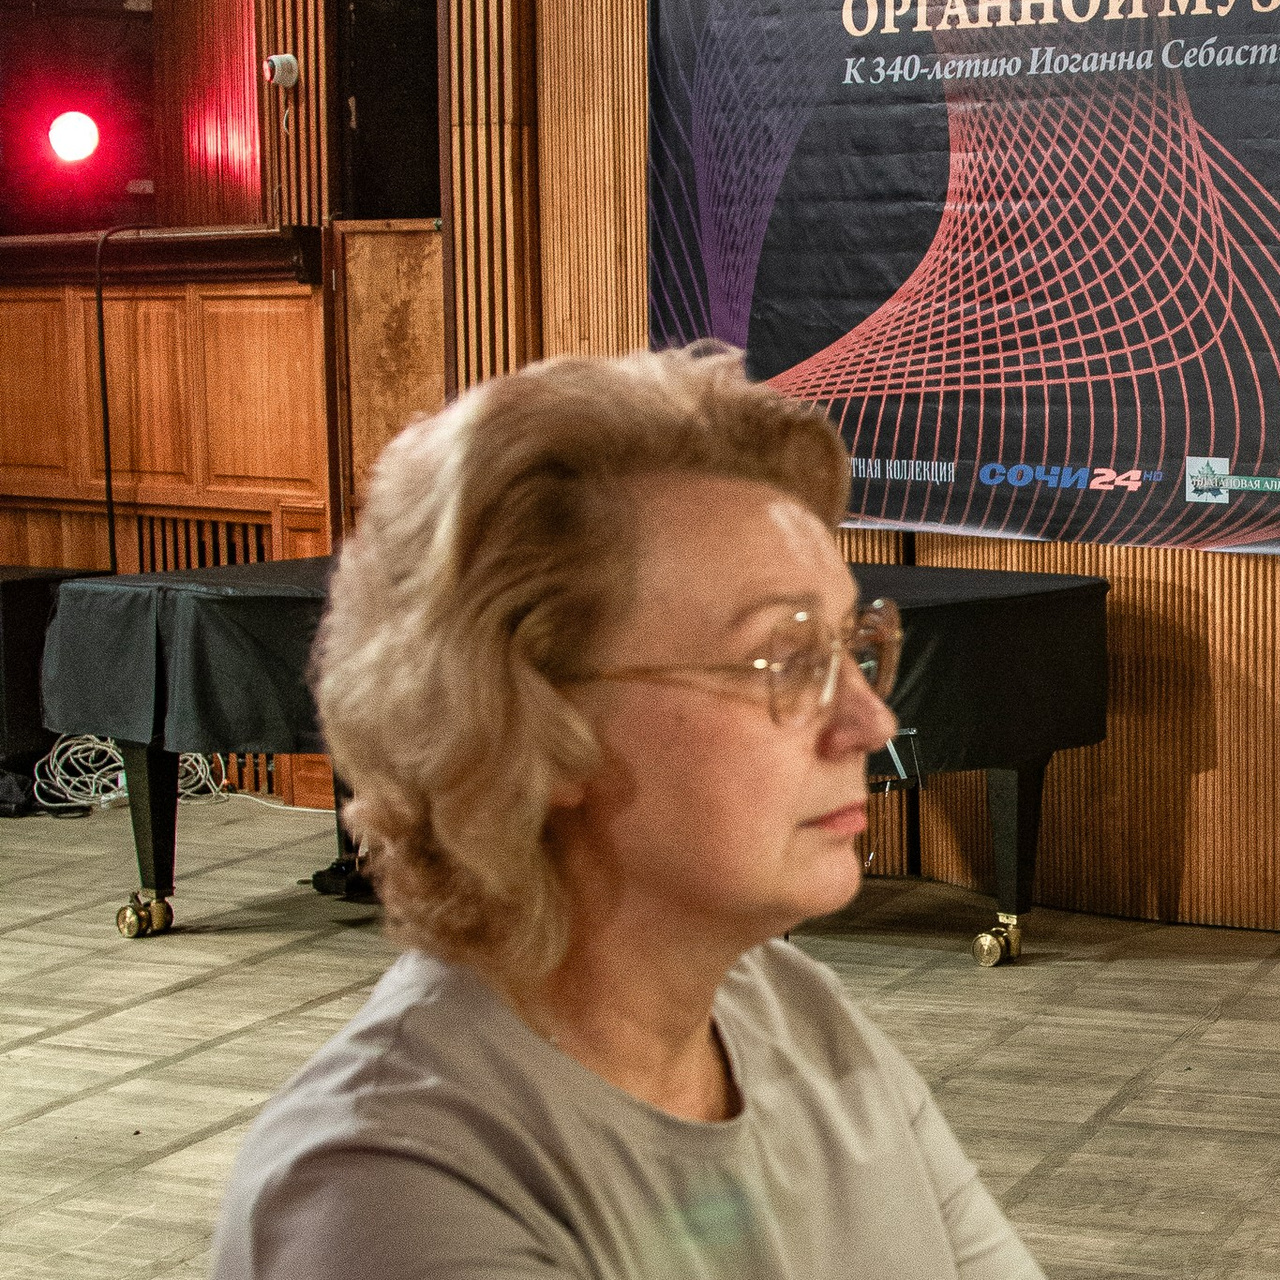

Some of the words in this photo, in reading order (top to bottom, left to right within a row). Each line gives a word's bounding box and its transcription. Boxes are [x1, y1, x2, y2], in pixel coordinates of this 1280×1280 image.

[842, 57, 866, 84] К
[869, 54, 1022, 84] 340-летию
[1027, 46, 1154, 74] Иоганна
[848, 456, 881, 479] ТНАЯ
[886, 459, 956, 486] КОЛЛЕКЦИЯ
